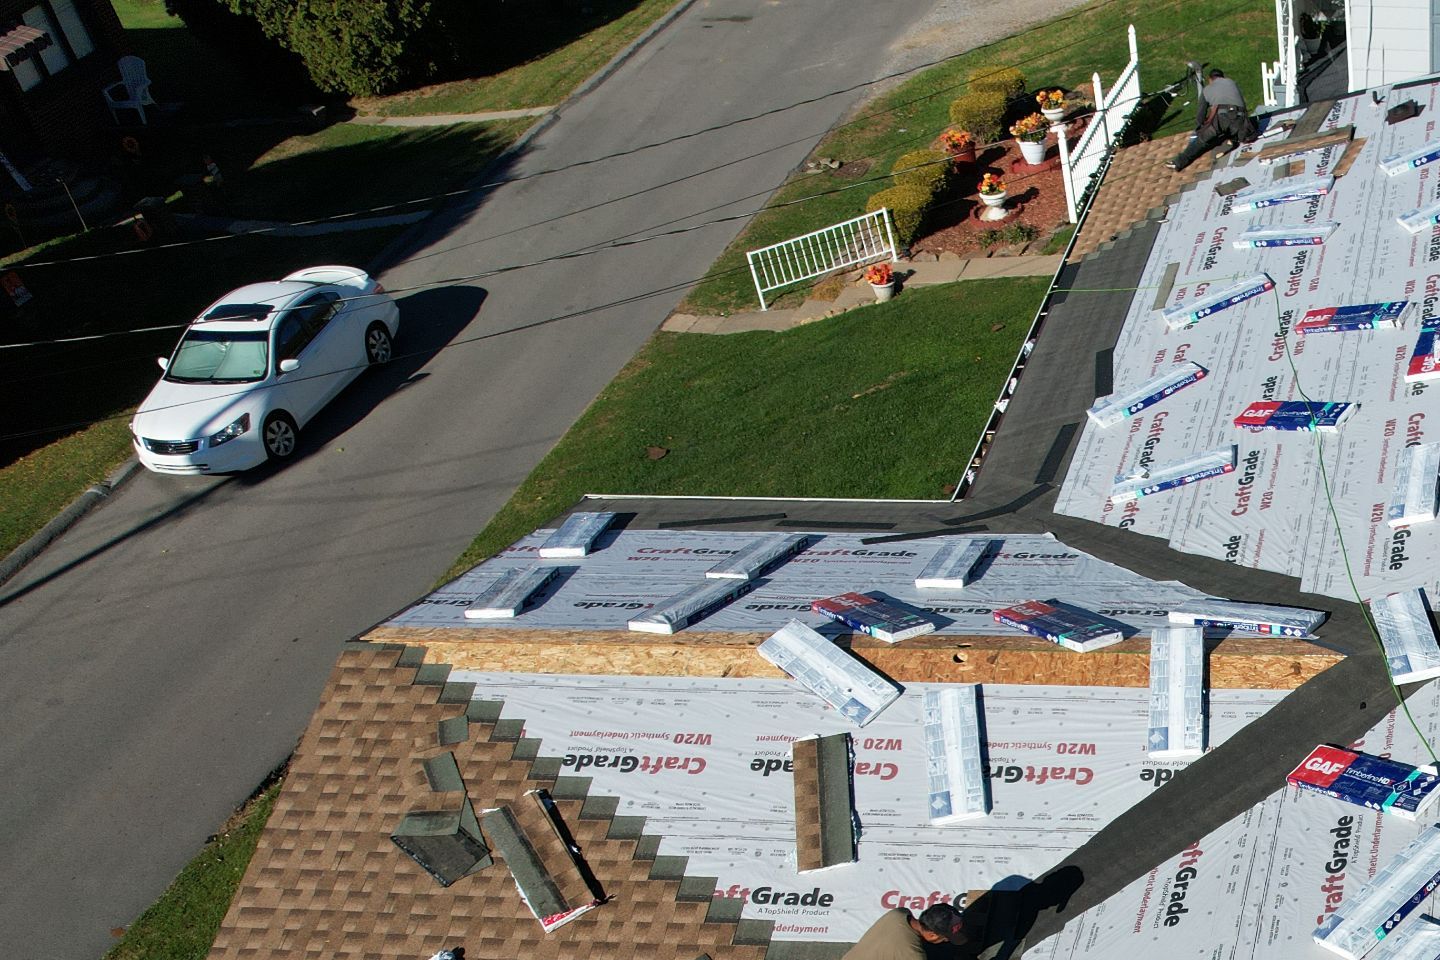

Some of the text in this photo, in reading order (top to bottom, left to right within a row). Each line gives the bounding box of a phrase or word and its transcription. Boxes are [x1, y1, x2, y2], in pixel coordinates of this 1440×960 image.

[1284, 250, 1308, 298] CraftGrade
[1304, 315, 1332, 323] GAF
[1243, 410, 1273, 418] GAF
[1130, 417, 1144, 432] W20
[1384, 418, 1397, 437] W20
[1231, 450, 1260, 516] CraftGrade
[1260, 491, 1273, 511] W20
[1371, 502, 1384, 523] W20
[569, 730, 712, 745] W20 Synthetic Underlayment
[863, 738, 902, 750] W20
[1057, 743, 1096, 755] W20
[562, 754, 707, 774] CraftGrade
[1305, 758, 1345, 775] GAF
[1316, 815, 1353, 925] raftGrade
[764, 908, 830, 917] TopShield Product
